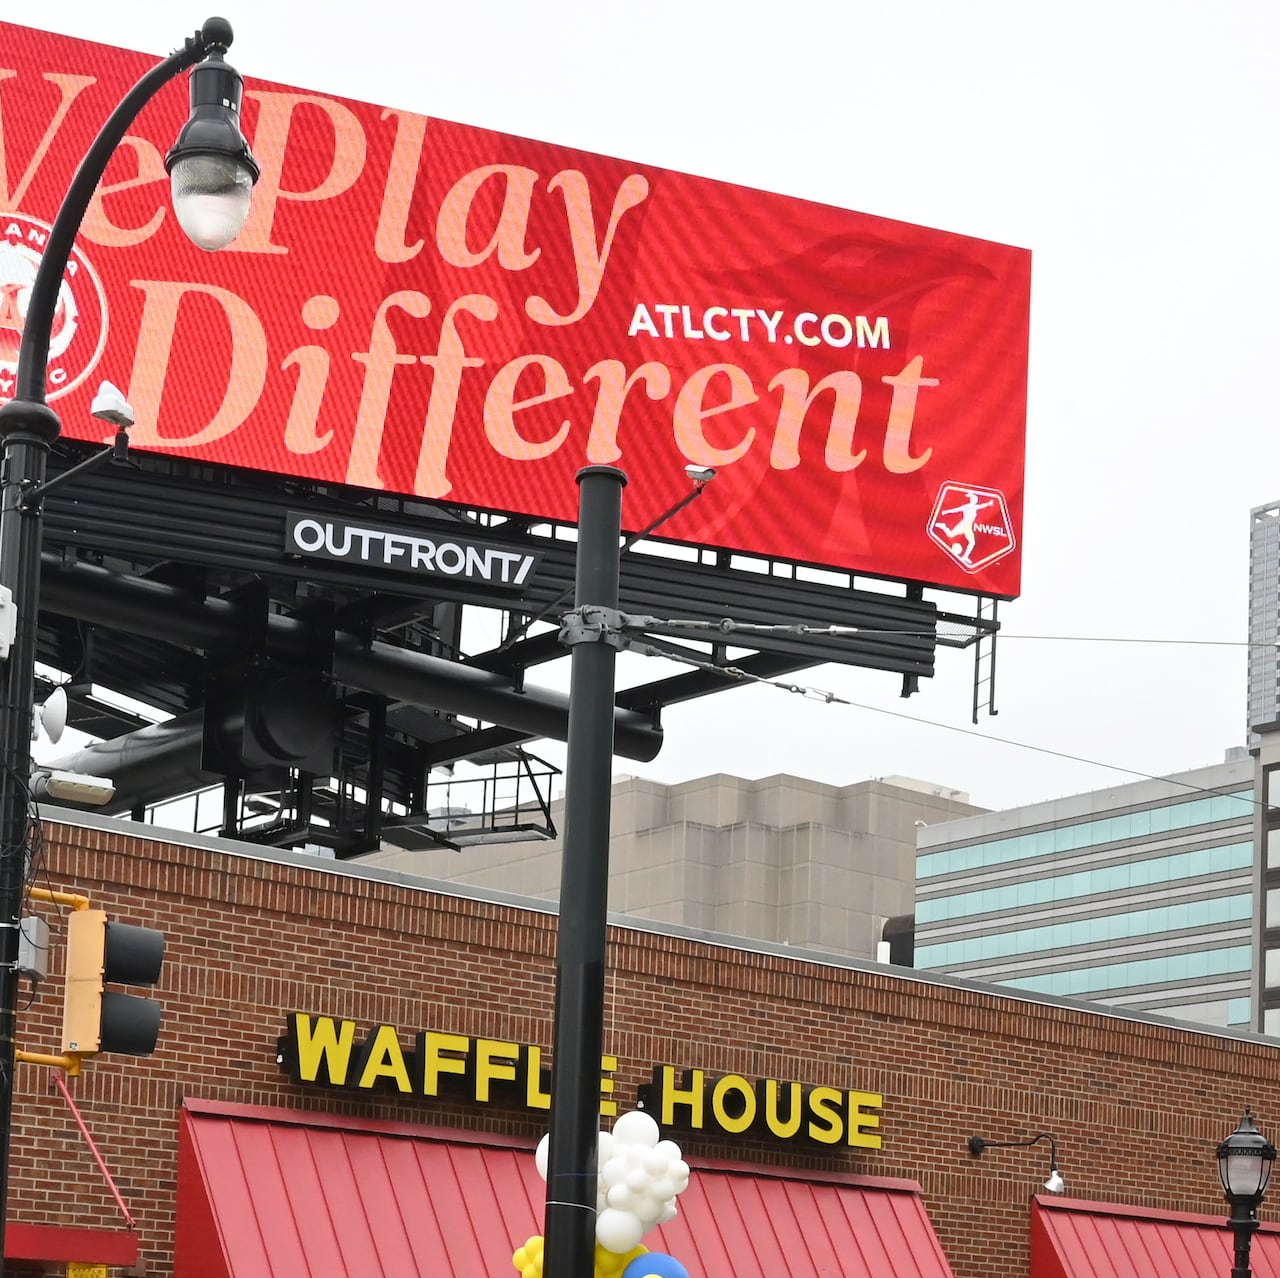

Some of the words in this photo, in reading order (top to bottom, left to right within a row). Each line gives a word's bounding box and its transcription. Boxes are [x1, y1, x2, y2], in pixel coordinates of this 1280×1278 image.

[225, 88, 649, 326] Play
[628, 303, 891, 350] ATLCTY.COM
[125, 279, 940, 499] Different
[973, 523, 1008, 537] NWSL
[661, 1065, 883, 1149] HOUSE
